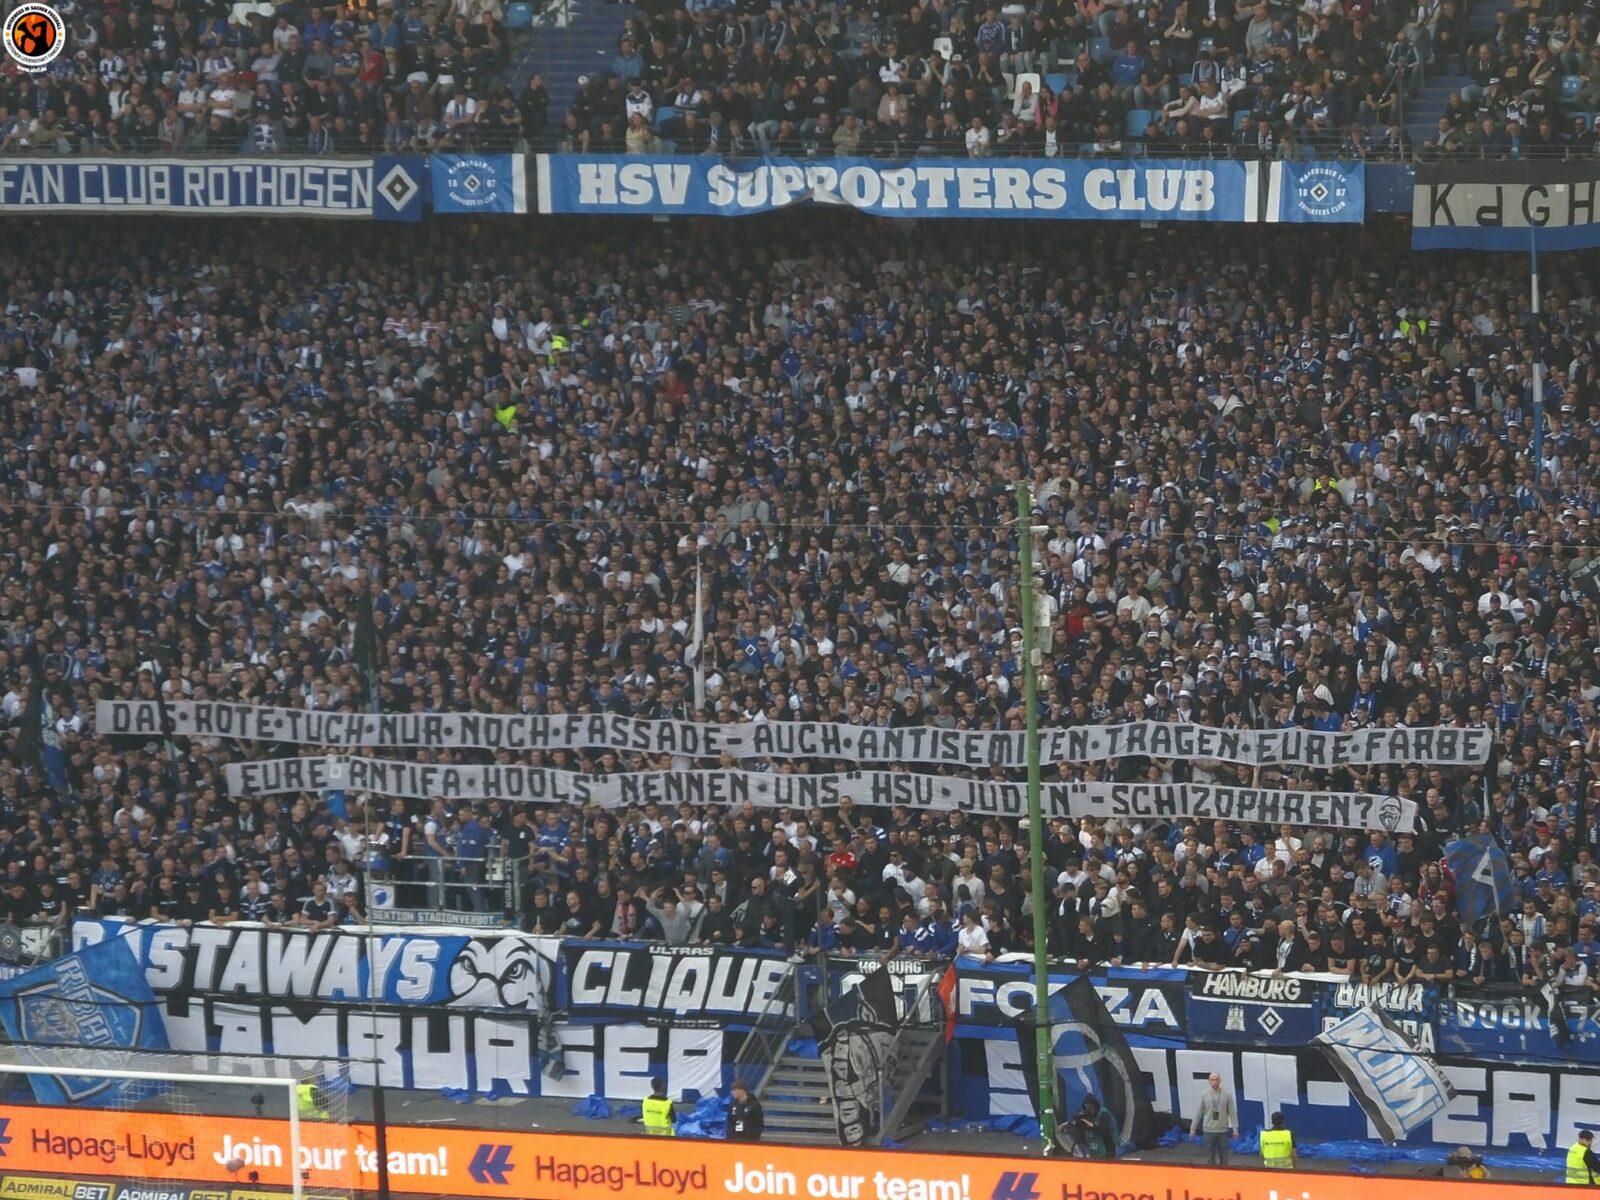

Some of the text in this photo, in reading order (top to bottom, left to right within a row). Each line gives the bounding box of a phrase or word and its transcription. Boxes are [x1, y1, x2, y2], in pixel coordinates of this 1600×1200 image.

[0, 164, 373, 209] FAN CLUB ROTHOSEN
[577, 163, 1215, 212] HSV SUPPORTERS CLUB
[193, 703, 275, 738] ROTE
[284, 708, 366, 746] TUCH
[377, 714, 445, 746] NUR
[460, 715, 550, 748] NOCH
[564, 715, 720, 755] FASSADE
[753, 723, 841, 756] AUCH
[1107, 723, 1240, 759] TRAGEN
[1257, 733, 1354, 766] EURE
[1365, 728, 1484, 761] FARBE
[240, 759, 328, 793] EURE
[620, 773, 749, 804] NENNEN
[774, 775, 839, 806] UNS
[1112, 784, 1374, 828] SCHIZOPHREN?
[372, 909, 495, 926] SEKTION STADIONVERBOT
[648, 945, 715, 956] ULTRAS
[571, 949, 794, 1016] CLIQUE
[958, 977, 1179, 1027] FOZA
[1202, 972, 1301, 1001] HAMBURG
[30, 1128, 195, 1167] Hapag-Lloyd
[213, 1134, 282, 1167] Join
[4, 1181, 107, 1200] ADMIRAL BET
[534, 1155, 970, 1200] Hapag-Lloyd Join our team!
